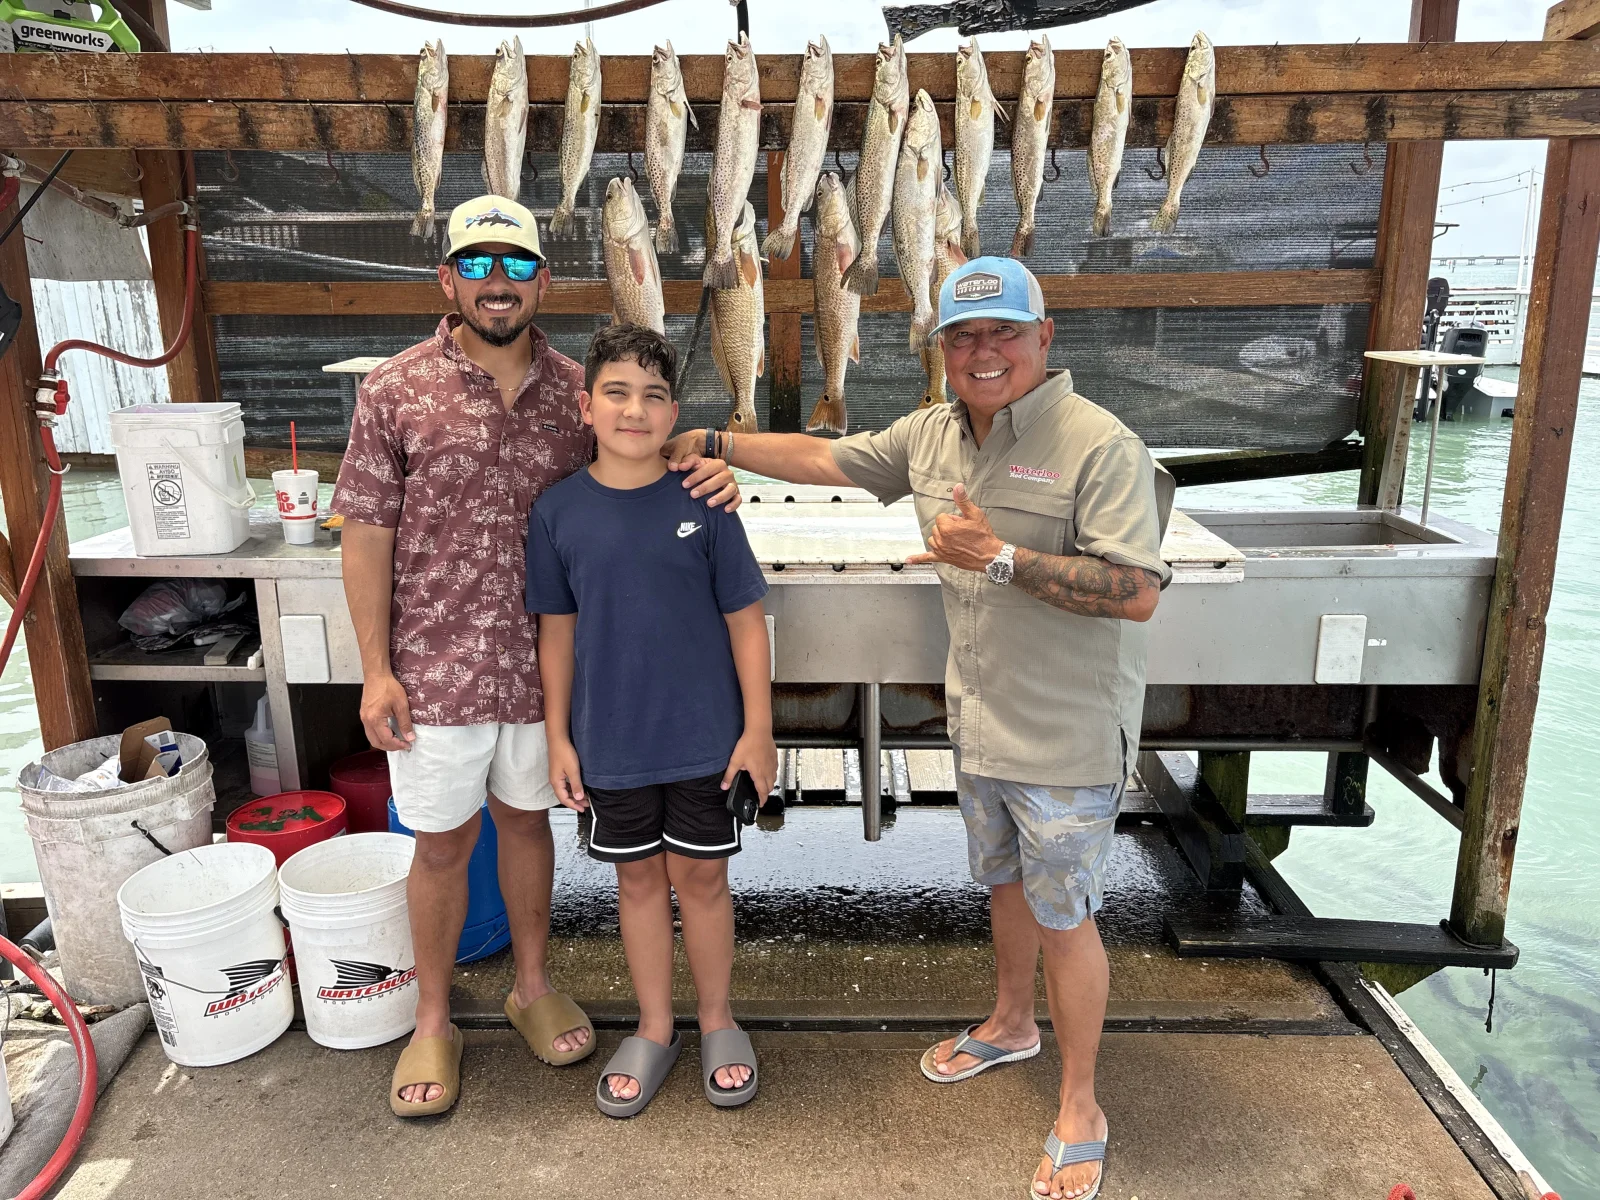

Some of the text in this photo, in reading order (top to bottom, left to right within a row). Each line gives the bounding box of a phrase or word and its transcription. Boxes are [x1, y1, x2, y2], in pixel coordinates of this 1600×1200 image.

[20, 25, 105, 48] greenworks
[1009, 464, 1061, 479] Waterloo
[1023, 474, 1055, 484] Company
[680, 522, 695, 532] NIKE
